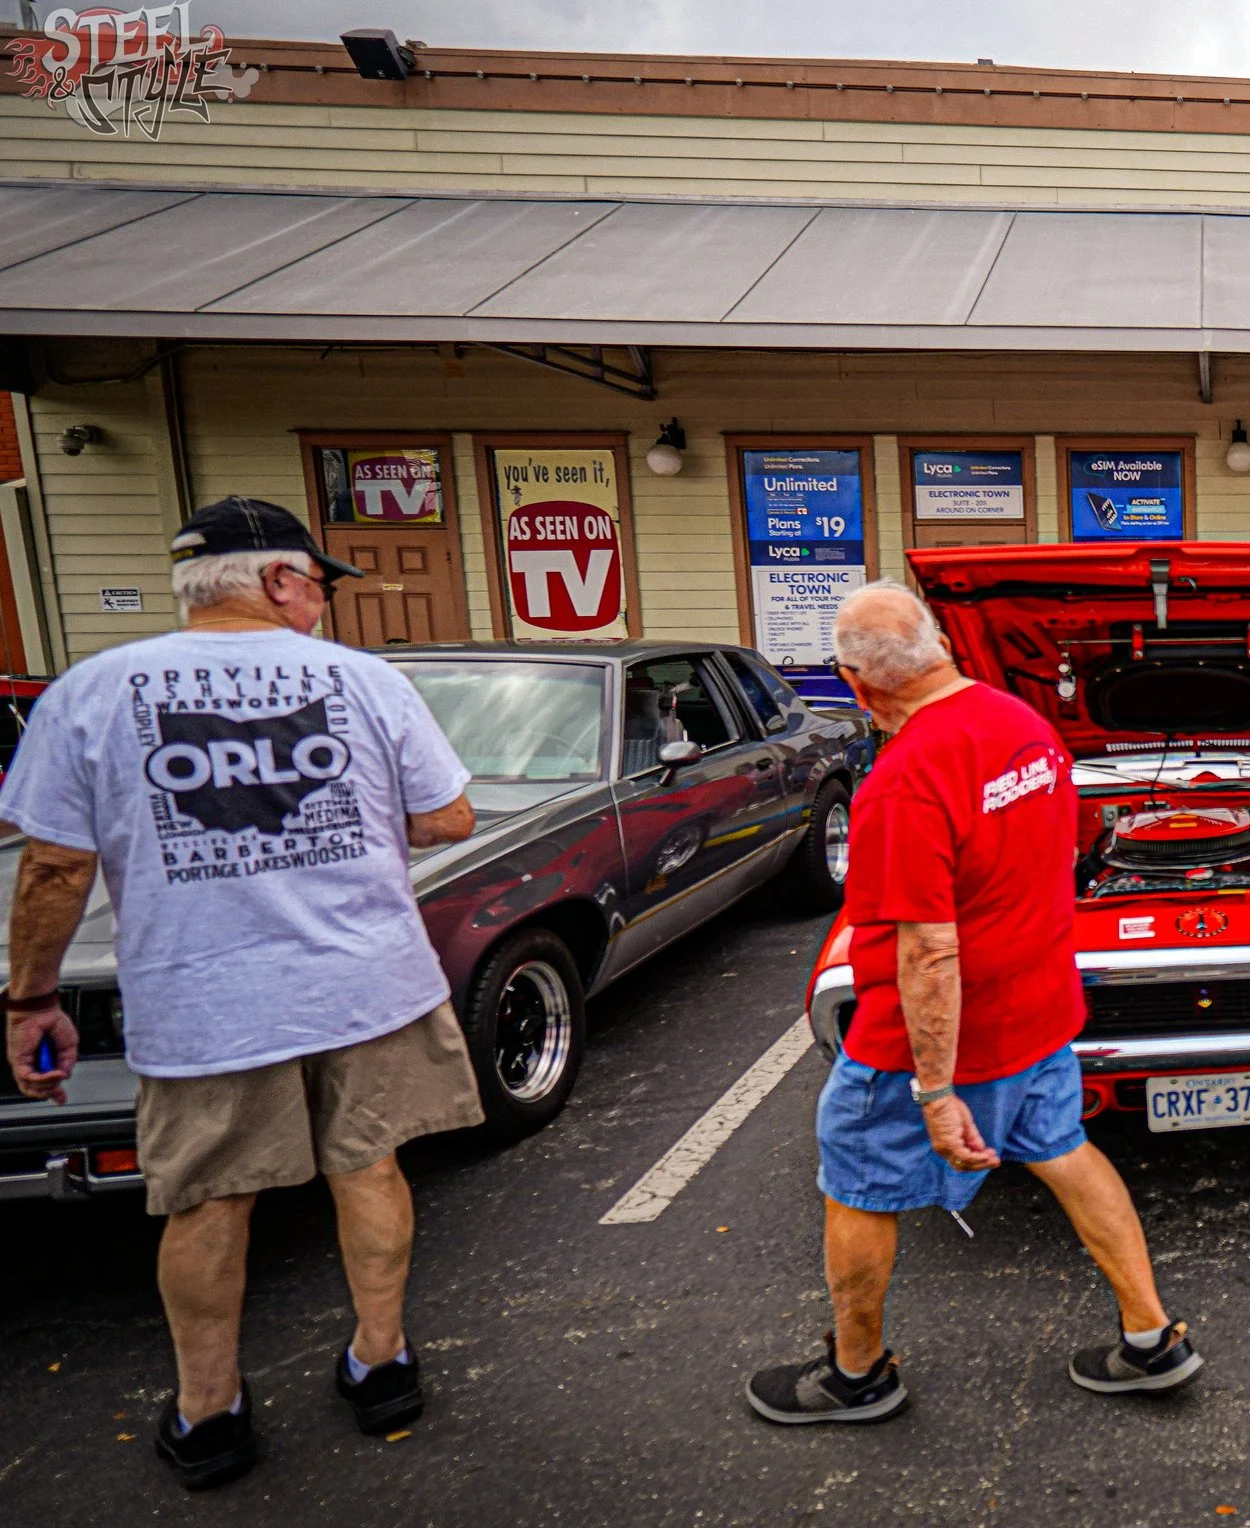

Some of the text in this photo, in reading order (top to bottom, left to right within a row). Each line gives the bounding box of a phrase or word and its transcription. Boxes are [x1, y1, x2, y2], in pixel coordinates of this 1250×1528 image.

[355, 465, 431, 479] AS SEEN ON
[504, 458, 610, 489] you've seen it,
[923, 463, 953, 475] Lyca
[1091, 461, 1162, 471] eSIM Available
[764, 478, 838, 492] Unlimited
[1113, 472, 1141, 481] NOW
[355, 480, 433, 515] TV
[509, 516, 612, 541] AS SEEN ON
[768, 517, 846, 537] Plans $19
[769, 530, 795, 538] Starting
[768, 546, 800, 559] Lyca
[510, 549, 614, 618] TV
[770, 573, 850, 583] ELECTRONIC
[789, 585, 832, 595] TOWN
[129, 665, 341, 688] ORRVILLE
[155, 695, 310, 711] WADSWORTH
[145, 734, 352, 792] ORLO
[305, 806, 362, 827] MEDINA
[162, 829, 365, 866] BARBERTON
[166, 862, 242, 885] PORTAGE
[1152, 1090, 1209, 1119] CRXF
